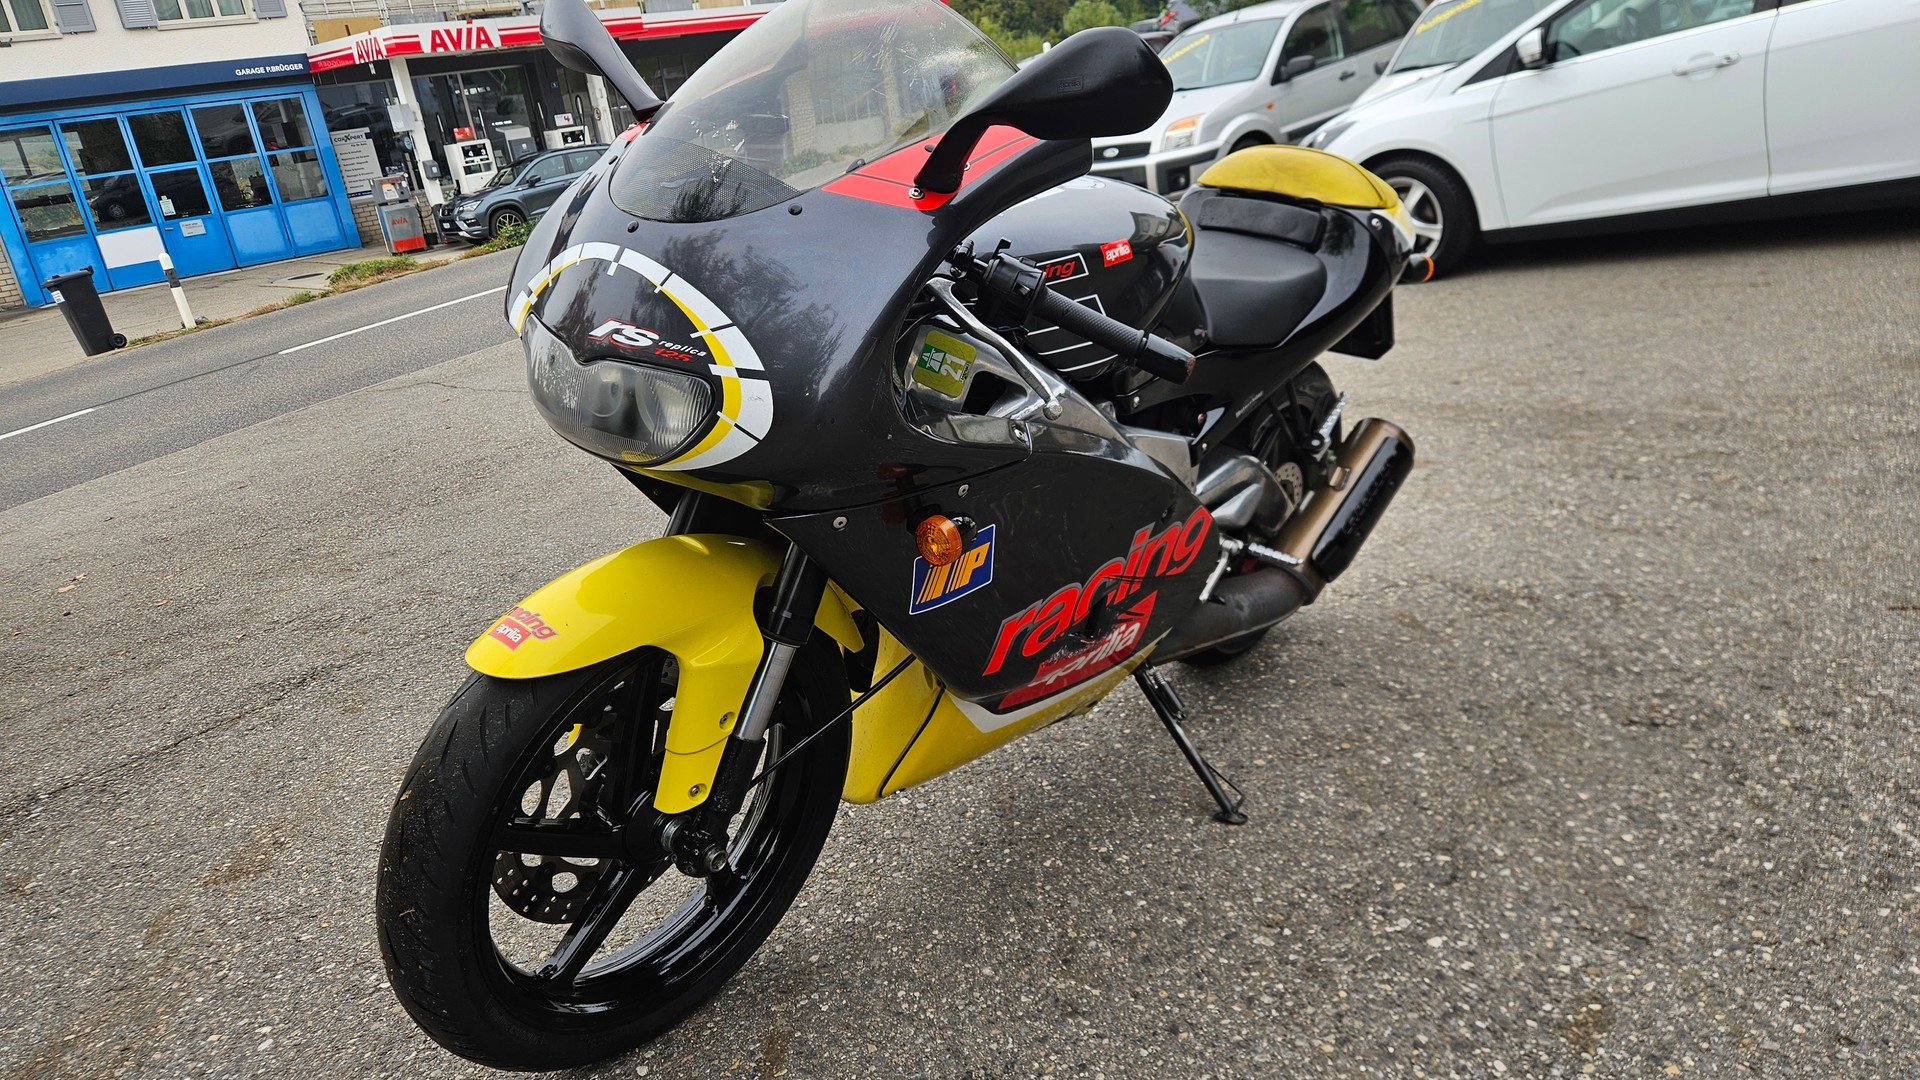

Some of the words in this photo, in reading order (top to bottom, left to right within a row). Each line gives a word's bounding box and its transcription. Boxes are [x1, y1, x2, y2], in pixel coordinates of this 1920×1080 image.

[430, 19, 494, 53] AVIA
[355, 31, 386, 64] AVIA
[235, 66, 266, 76] GARAGE
[266, 63, 304, 73] P.BRÜGGER
[391, 216, 409, 226] AVIA
[1105, 243, 1131, 261] aprilia
[655, 347, 693, 363] 125
[658, 340, 707, 357] replica
[940, 353, 967, 381] 21
[982, 506, 1213, 677] racing
[495, 623, 522, 643] aprilia
